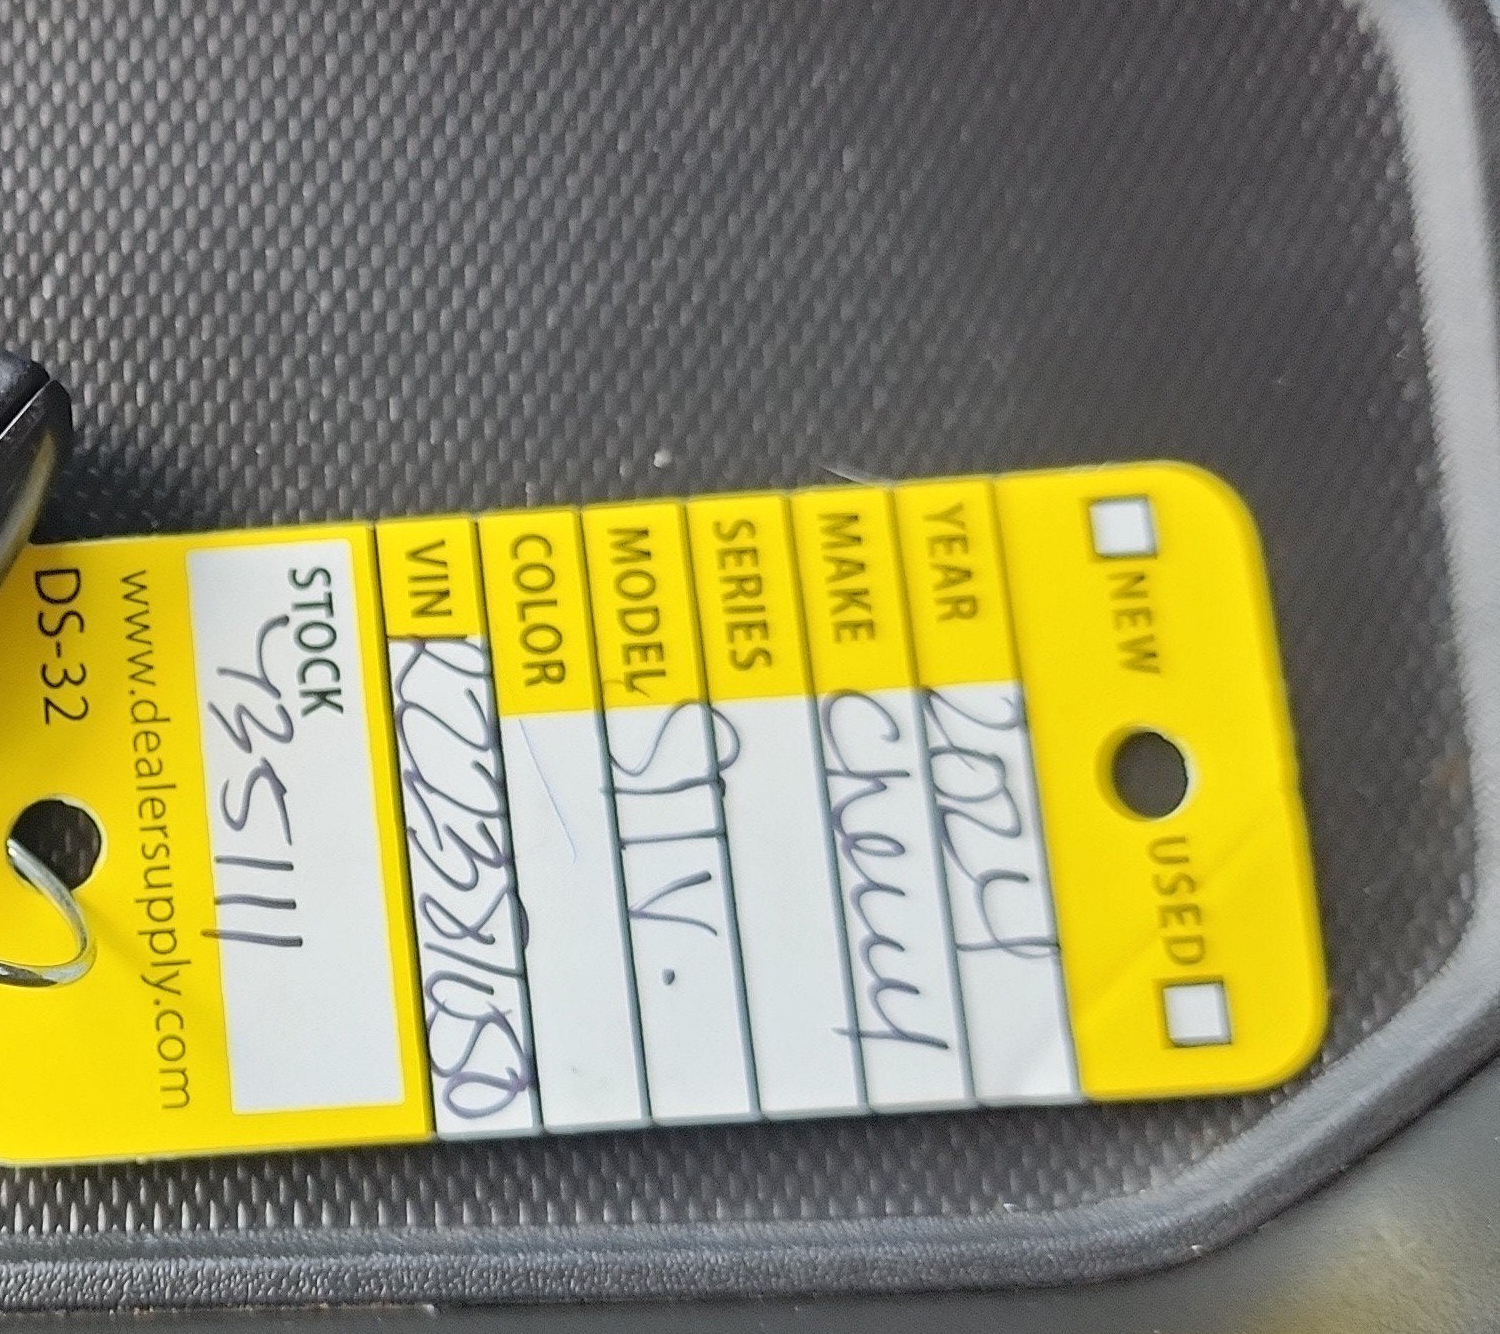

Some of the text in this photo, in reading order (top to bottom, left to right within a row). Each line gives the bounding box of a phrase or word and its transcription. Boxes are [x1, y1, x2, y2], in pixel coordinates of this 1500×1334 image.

[404, 540, 452, 620] VIN
[509, 531, 568, 688] COLOR
[607, 525, 668, 693] MODEL
[712, 518, 772, 672] SERIES
[817, 511, 876, 645] MAKE
[923, 501, 978, 622] YEAR
[1107, 568, 1162, 675] NEW
[34, 567, 90, 726] DS-32
[288, 566, 344, 715] STOCK
[120, 569, 192, 1110] www.dealersupply.com
[918, 685, 1061, 958] 2024
[1148, 835, 1207, 966] USED
